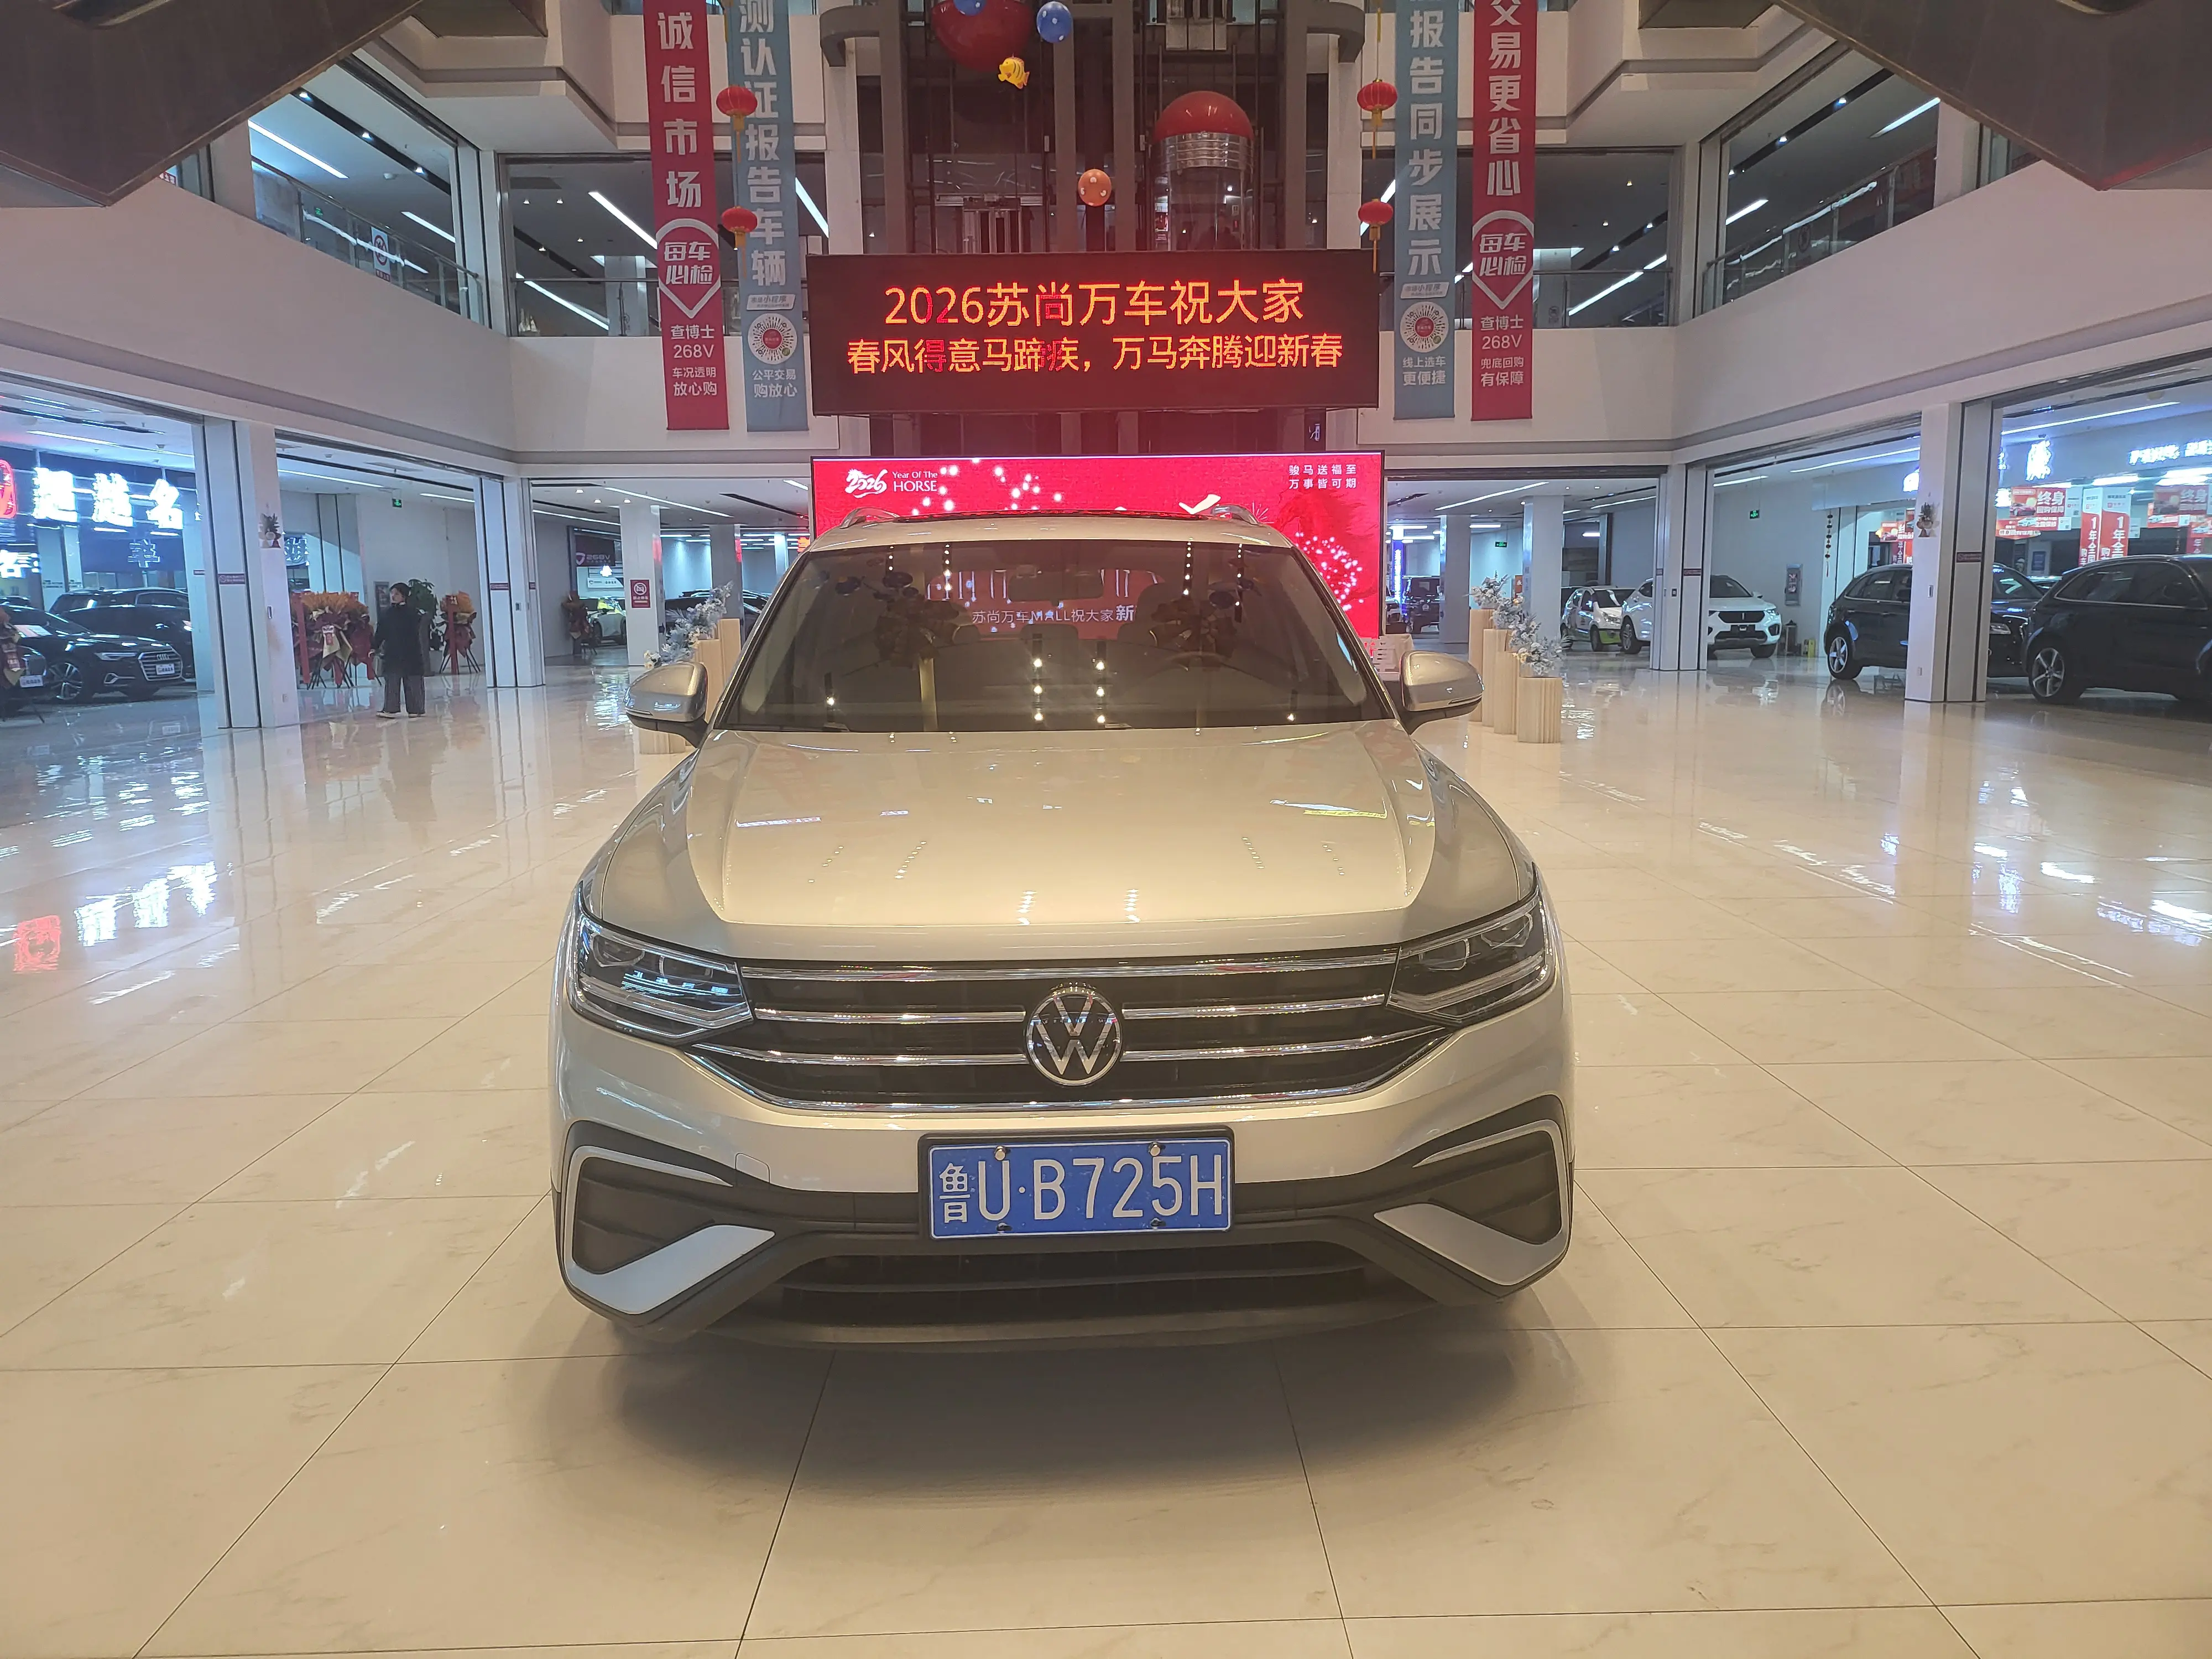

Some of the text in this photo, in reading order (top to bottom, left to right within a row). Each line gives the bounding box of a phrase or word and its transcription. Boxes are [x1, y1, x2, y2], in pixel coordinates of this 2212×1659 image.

[658, 12, 702, 208] 诚信市场
[1408, 0, 1444, 276] 报告同步展示
[885, 279, 1304, 328] 2026苏尚万车祝大家
[1480, 316, 1524, 330] 查博士
[671, 325, 714, 340] 查博士
[1481, 335, 1522, 350] 268V
[674, 344, 714, 358] 268V
[1402, 356, 1446, 368] 线上选车
[1480, 357, 1524, 369] 兜底回购
[672, 367, 716, 378] 车况透明
[752, 369, 796, 381] 公平交易
[1402, 371, 1446, 386] 更便捷
[1480, 371, 1524, 387] 有保障
[673, 382, 717, 396] 放心购
[753, 383, 798, 398] 购放心
[1289, 465, 1357, 475] 骏马送福至
[894, 481, 937, 492] HORSE
[1289, 478, 1357, 489] 万事皆可期
[2037, 491, 2064, 505] 终身
[939, 1154, 1223, 1223] 鲁U·B725H
